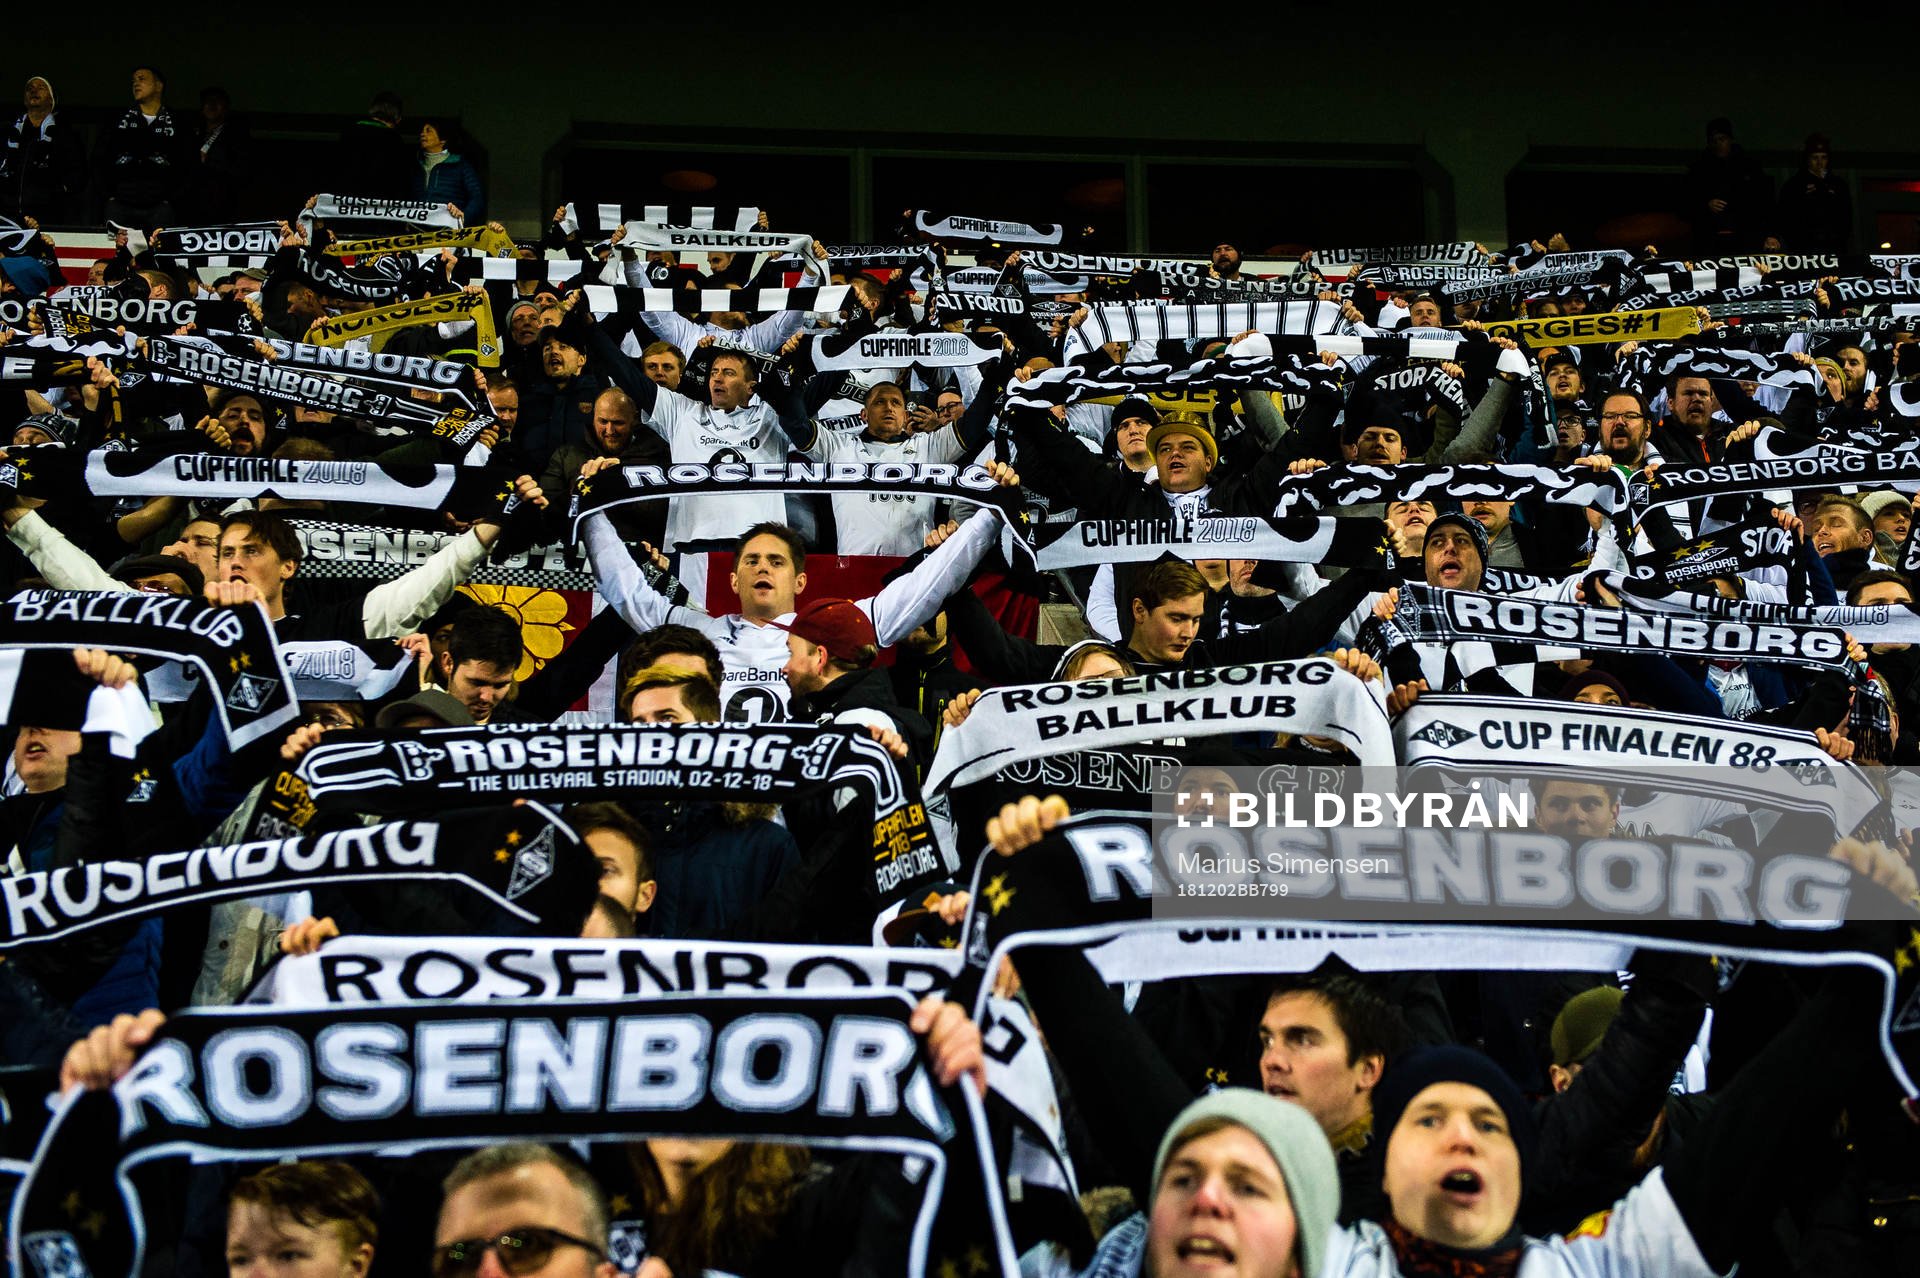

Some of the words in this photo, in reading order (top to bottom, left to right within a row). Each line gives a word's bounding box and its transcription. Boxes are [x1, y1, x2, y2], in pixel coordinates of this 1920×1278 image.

[338, 204, 429, 221] BALLKLUB
[949, 216, 999, 234] CUPFINALE
[670, 233, 791, 247] BALLKLUB
[964, 293, 1025, 315] FORTID
[861, 338, 931, 358] CUPFINALE
[932, 337, 969, 356] 2018
[178, 346, 364, 410] ROSENBORG
[184, 369, 203, 379] THE
[174, 455, 299, 483] CUPFINALE
[302, 460, 368, 485] 2018
[622, 462, 1000, 488] ROSENBORG
[1659, 454, 1866, 488] ROSENBORG
[1080, 516, 1193, 549] CUPFINALE
[1196, 516, 1258, 544] 2018
[1664, 556, 1739, 581] ROSENBORG
[14, 597, 244, 648] BALLKLUB
[1452, 593, 1843, 660] ROSENBORG
[293, 648, 356, 681] 2018
[1002, 661, 1335, 715] ROSENBORG
[1036, 695, 1297, 741] BALLKLUB
[445, 732, 792, 773] ROSENBORG
[1426, 728, 1457, 742] RBK
[1479, 718, 1555, 753] CUP
[1562, 722, 1724, 765] FINALEN
[1728, 741, 1777, 775] 88
[467, 776, 501, 792] THE
[507, 773, 597, 790] ULLEVAAL
[603, 769, 685, 788] STADION,
[688, 771, 773, 791] 02-12-18
[1066, 822, 1853, 931] ROSENBORG
